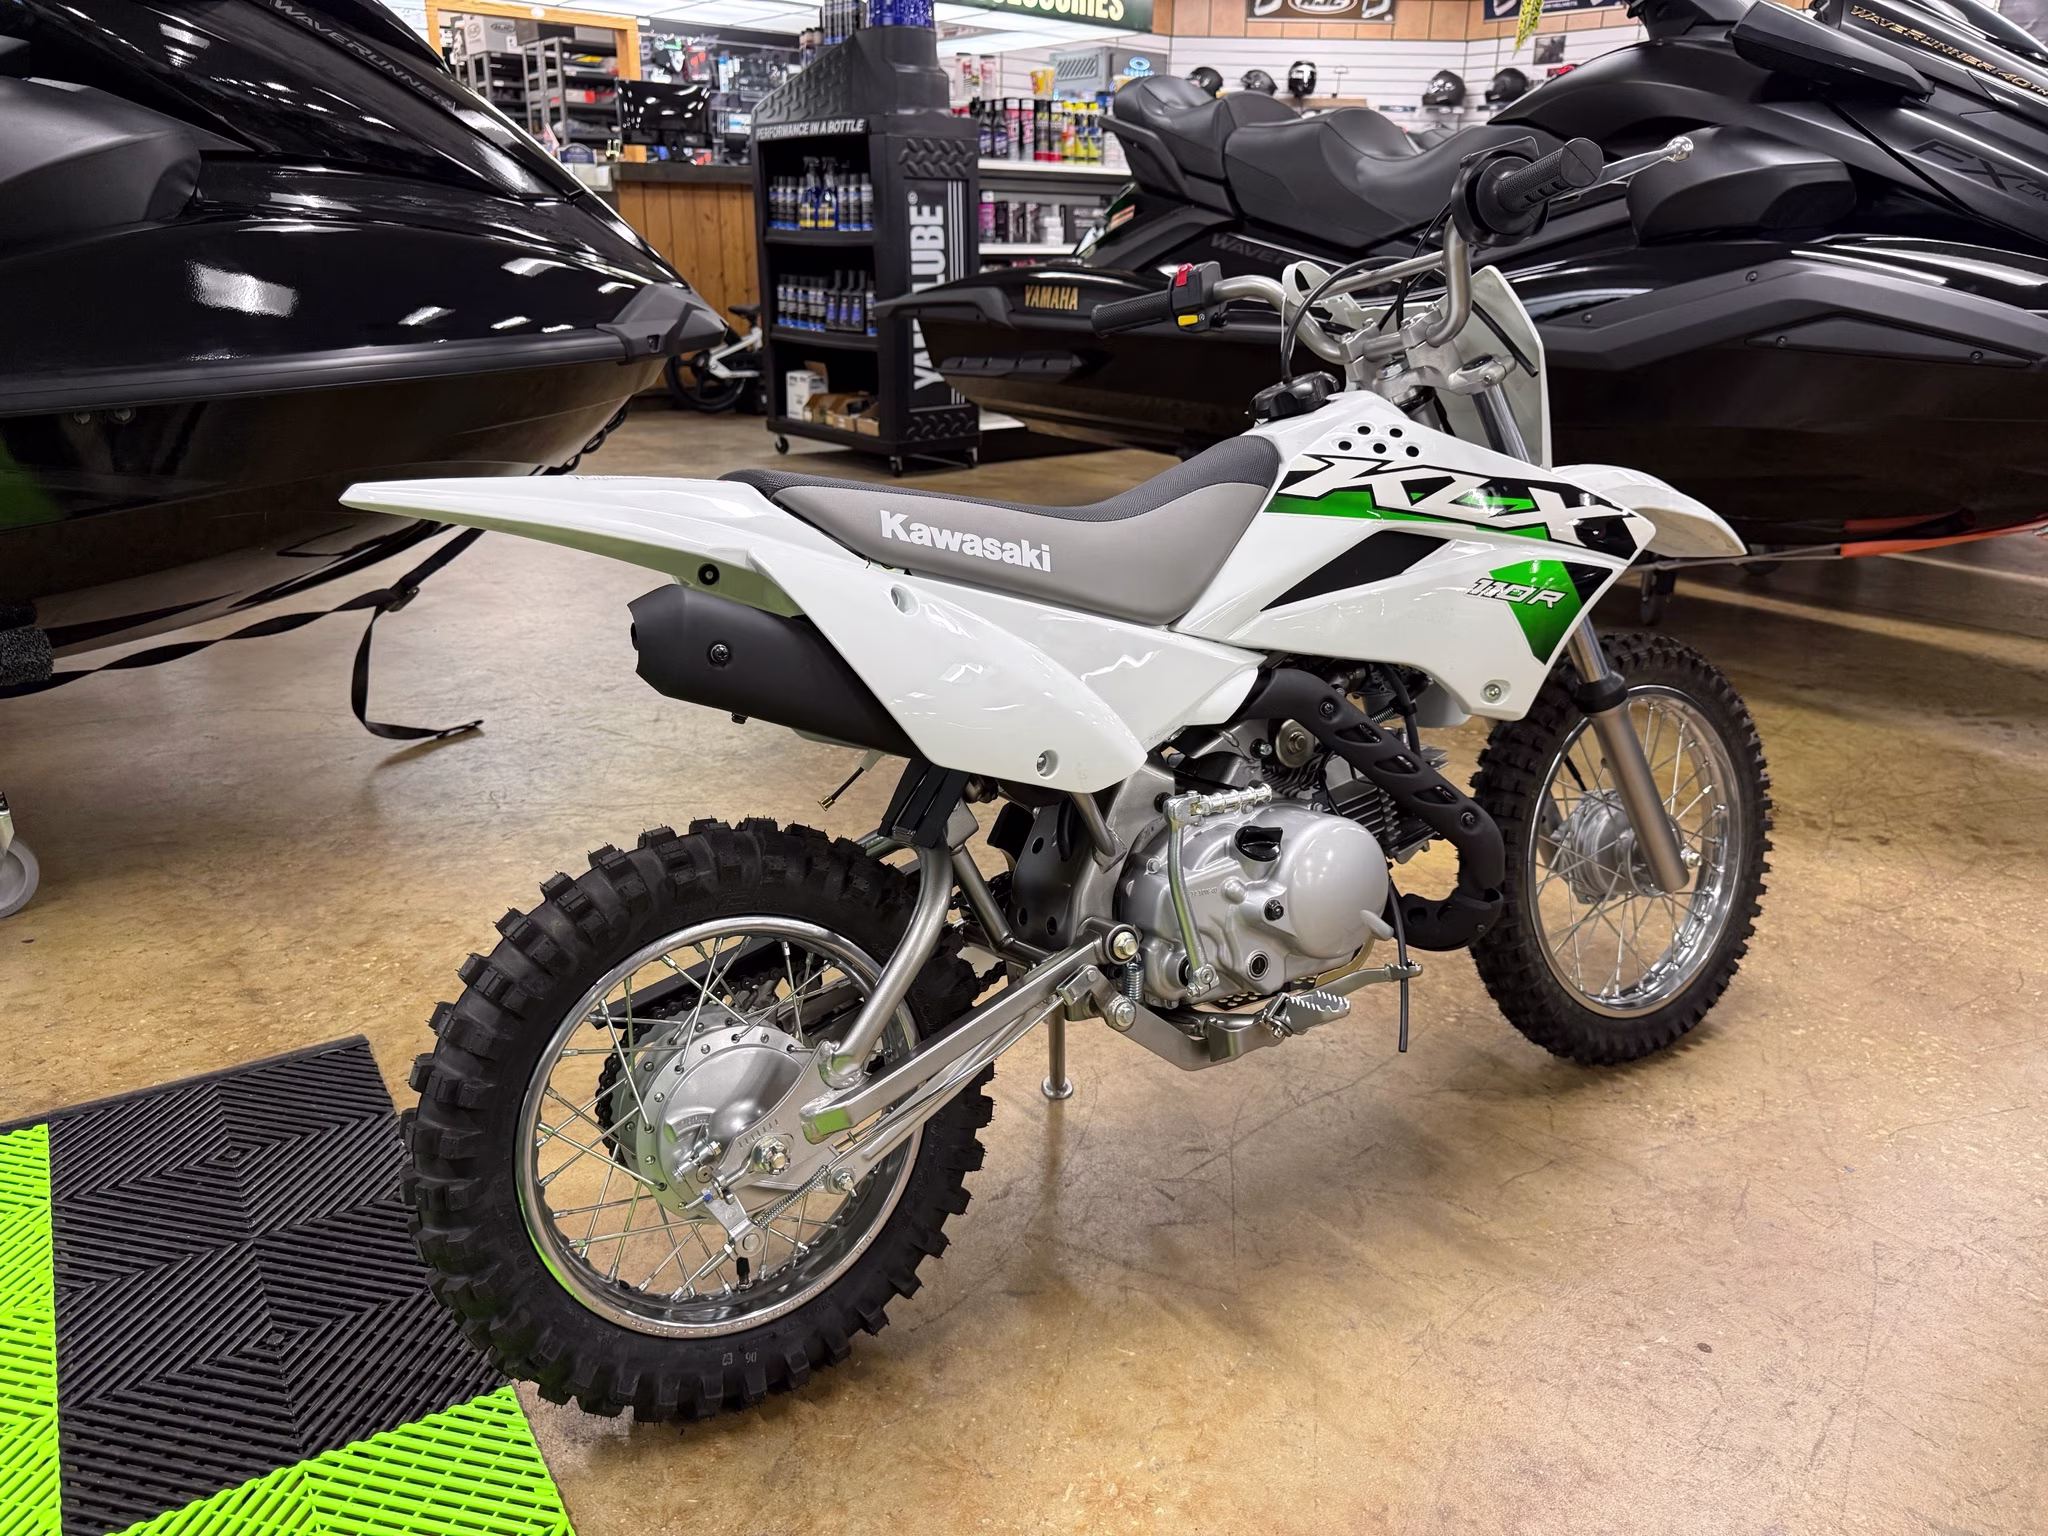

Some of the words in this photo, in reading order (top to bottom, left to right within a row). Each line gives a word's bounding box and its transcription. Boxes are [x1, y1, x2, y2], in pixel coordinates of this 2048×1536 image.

[1850, 6, 1997, 73] WAVERUNNER
[756, 122, 809, 140] PERFORMANCE
[810, 121, 820, 134] IN
[820, 120, 827, 133] A
[827, 118, 865, 133] BOTTLE
[1024, 285, 1079, 310] YAMAHA
[879, 510, 1051, 572] Kawasaki
[1465, 578, 1568, 609] 110R
